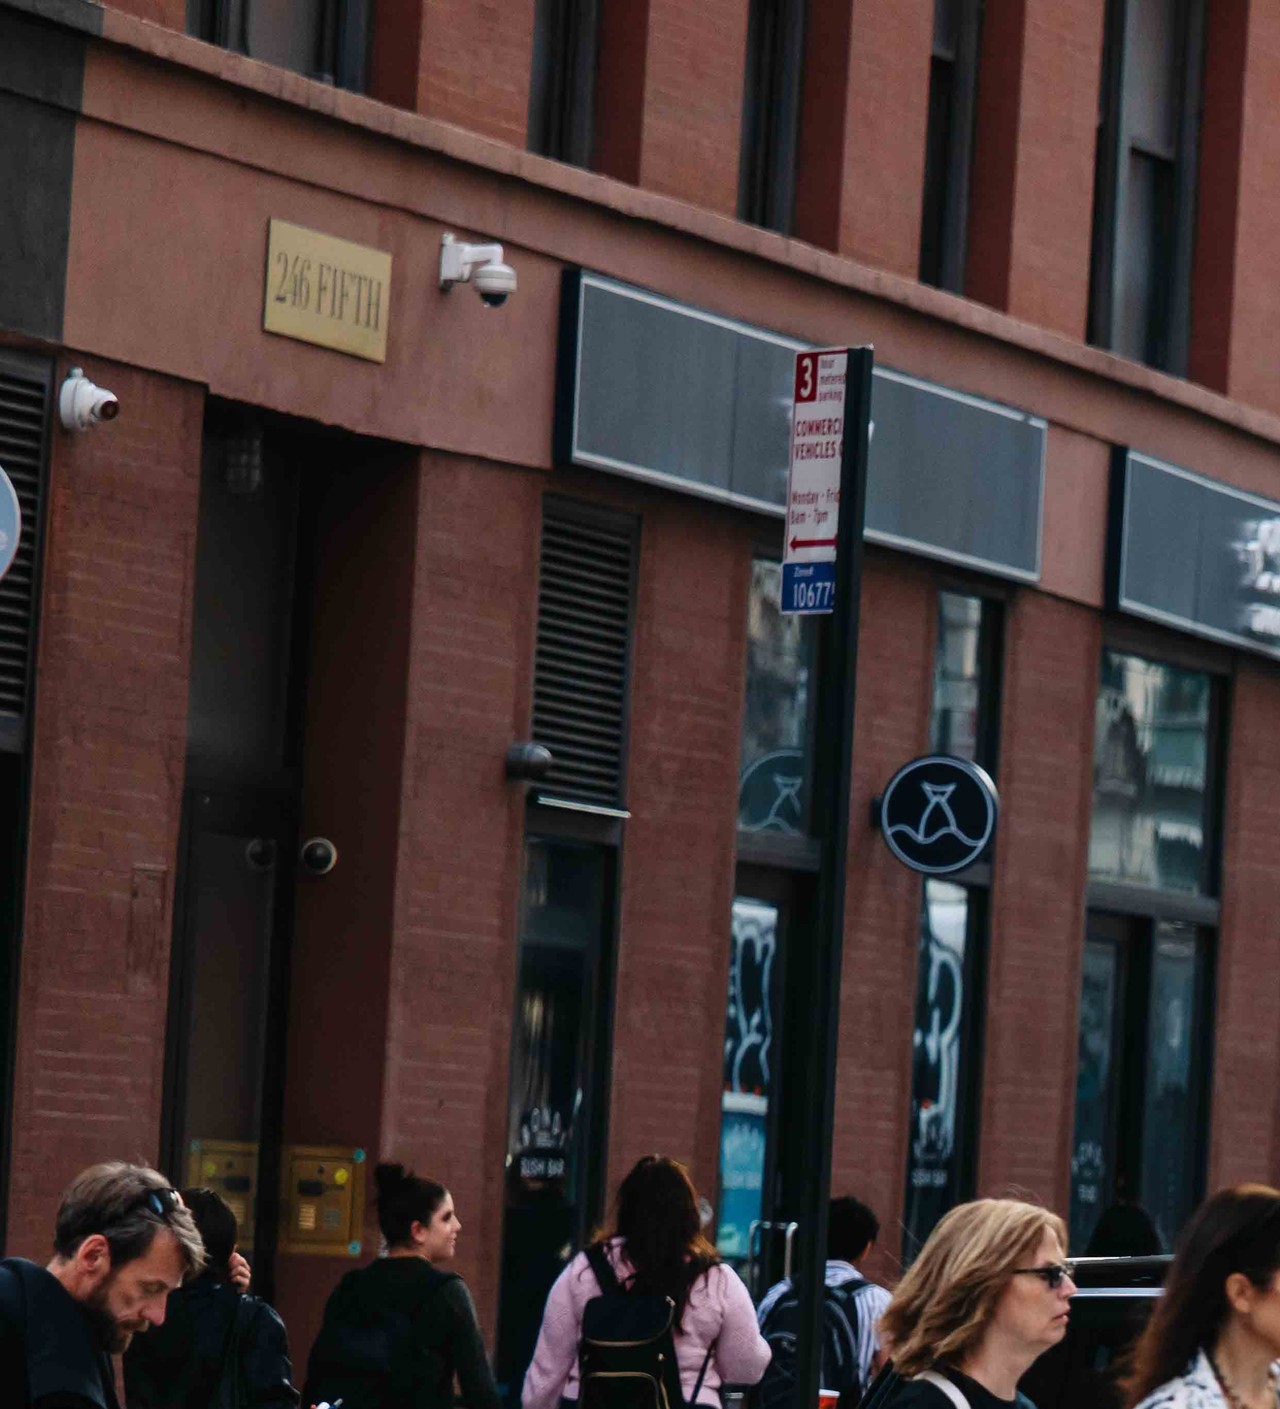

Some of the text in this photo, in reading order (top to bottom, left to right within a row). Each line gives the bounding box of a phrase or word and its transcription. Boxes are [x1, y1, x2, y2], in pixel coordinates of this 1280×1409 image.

[275, 252, 381, 331] 246 FIFTH
[801, 357, 813, 398] 3
[794, 441, 835, 459] VEHICLES
[792, 491, 818, 504] Monday
[791, 510, 806, 525] 8am
[814, 508, 828, 526] 7pm
